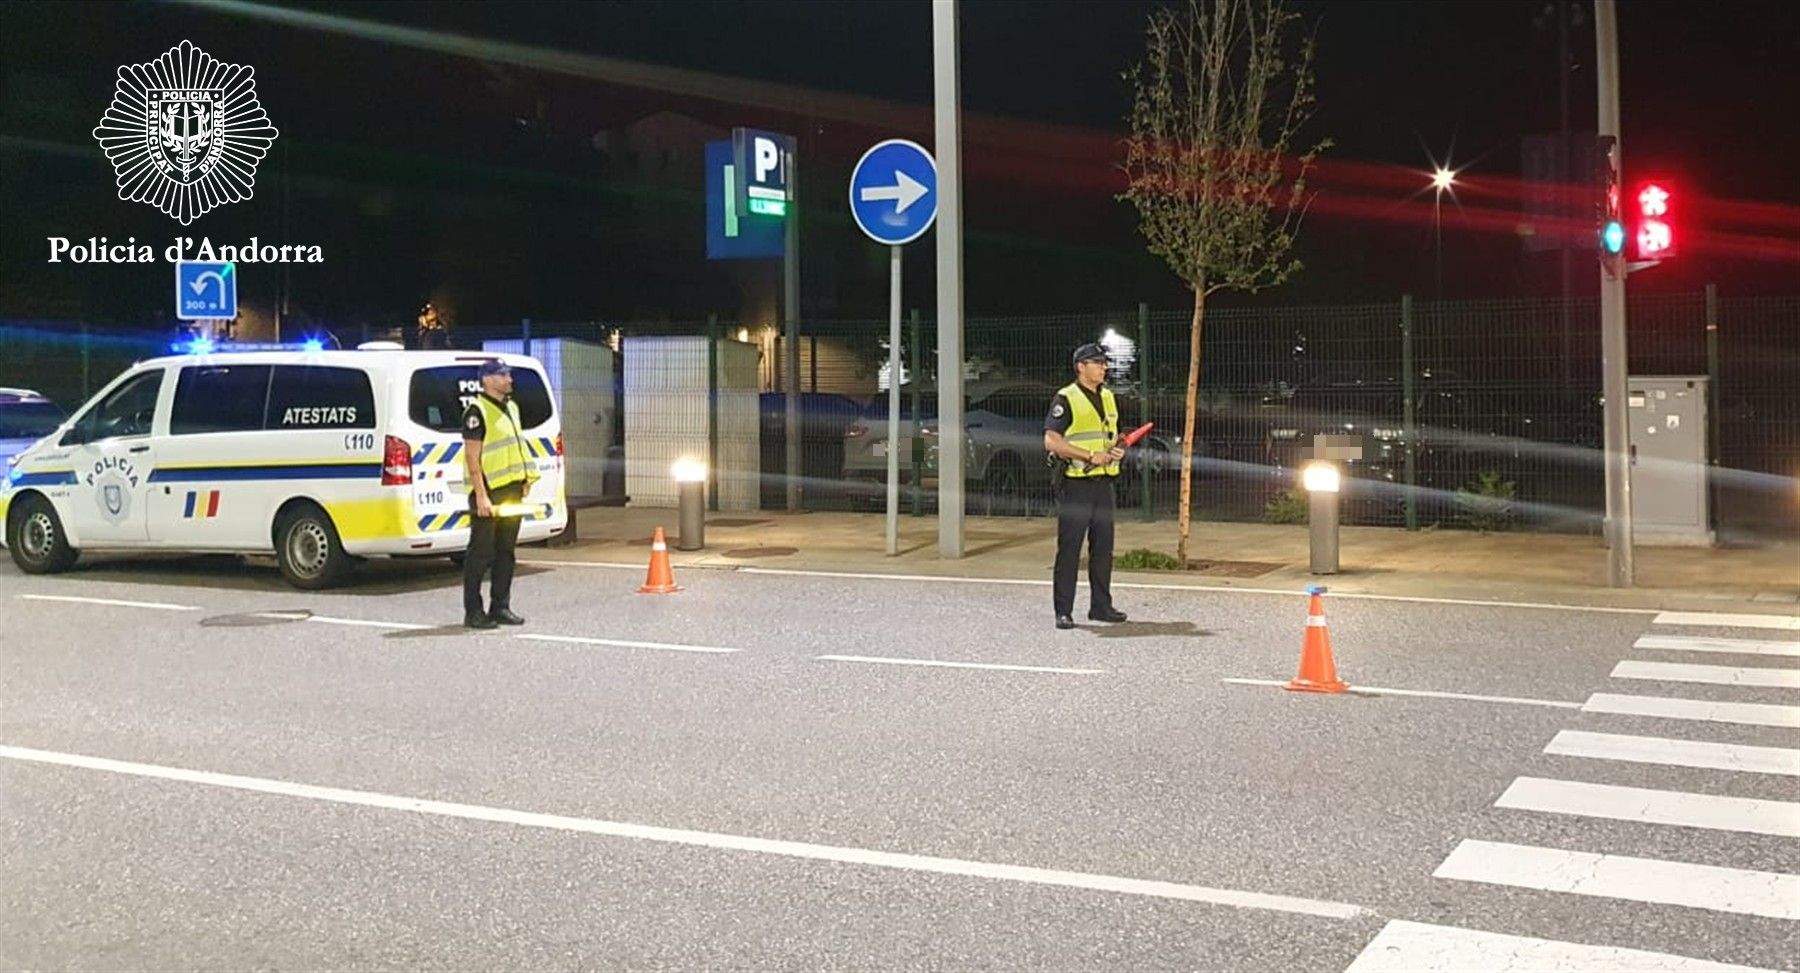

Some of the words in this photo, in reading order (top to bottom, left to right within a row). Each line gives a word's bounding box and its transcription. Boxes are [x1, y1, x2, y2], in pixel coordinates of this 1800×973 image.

[755, 137, 778, 182] P
[186, 300, 206, 310] 300
[459, 381, 484, 393] POL
[283, 407, 357, 424] ATESTATS
[351, 434, 374, 449] 110
[86, 456, 139, 488] POLICIA
[425, 491, 443, 503] 110
